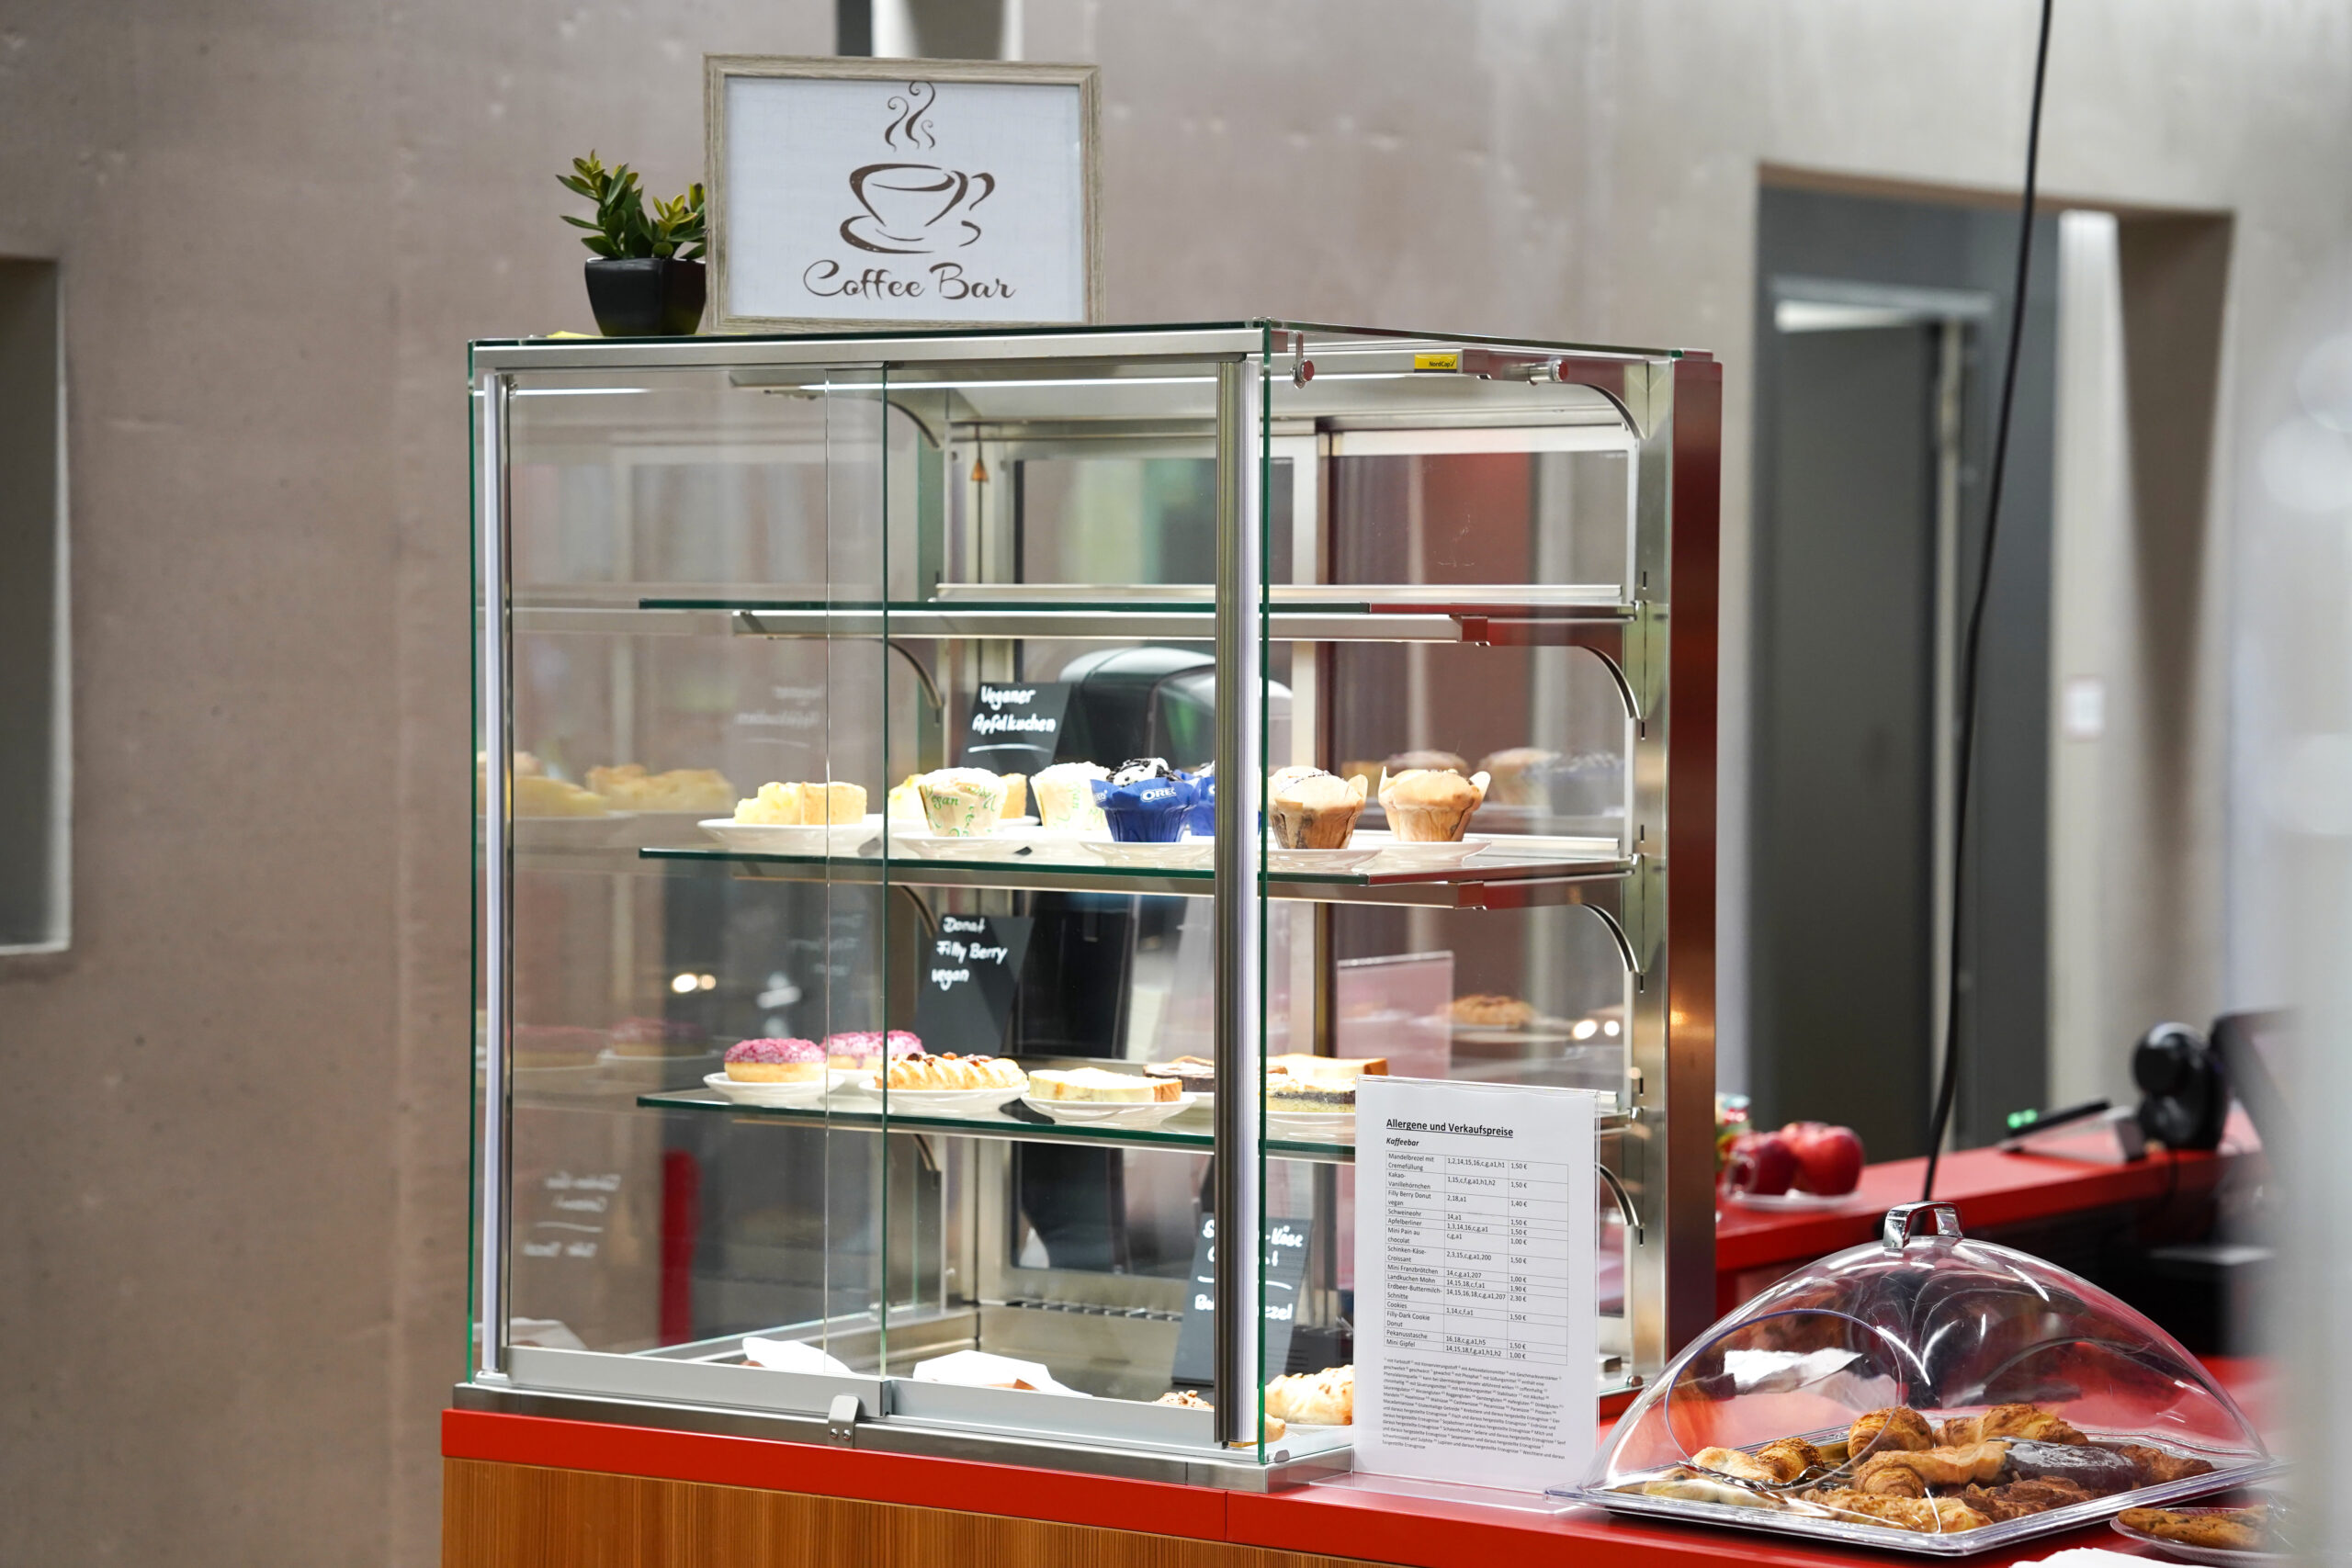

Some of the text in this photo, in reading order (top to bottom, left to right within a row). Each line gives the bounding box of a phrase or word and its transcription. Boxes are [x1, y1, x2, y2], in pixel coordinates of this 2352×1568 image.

[803, 260, 1016, 300] Coffee Bar
[981, 685, 1036, 710] Veganer
[972, 713, 1056, 735] Apfelkuchen
[969, 943, 1008, 964] Berry
[1386, 1119, 1513, 1137] Allergene und Verkaufspreise
[1386, 1137, 1419, 1147] Kaffeebar
[1388, 1153, 1424, 1162] Mandelbrezel
[1388, 1162, 1423, 1171] Cremefüllung
[1388, 1181, 1430, 1190] Vanillehörnchen
[1388, 1218, 1422, 1226] Apfelberliner
[1387, 1246, 1426, 1255] Schinken-Käse-
[1400, 1265, 1438, 1275] Franzbrötchen
[1387, 1274, 1417, 1283] Landkuchen
[1387, 1283, 1442, 1294] Erdbeer-Buttermilch-
[1387, 1311, 1411, 1320] Filly-Dark
[1387, 1330, 1427, 1340] Pekanusstasche
[1400, 1340, 1415, 1348] Gipfel
